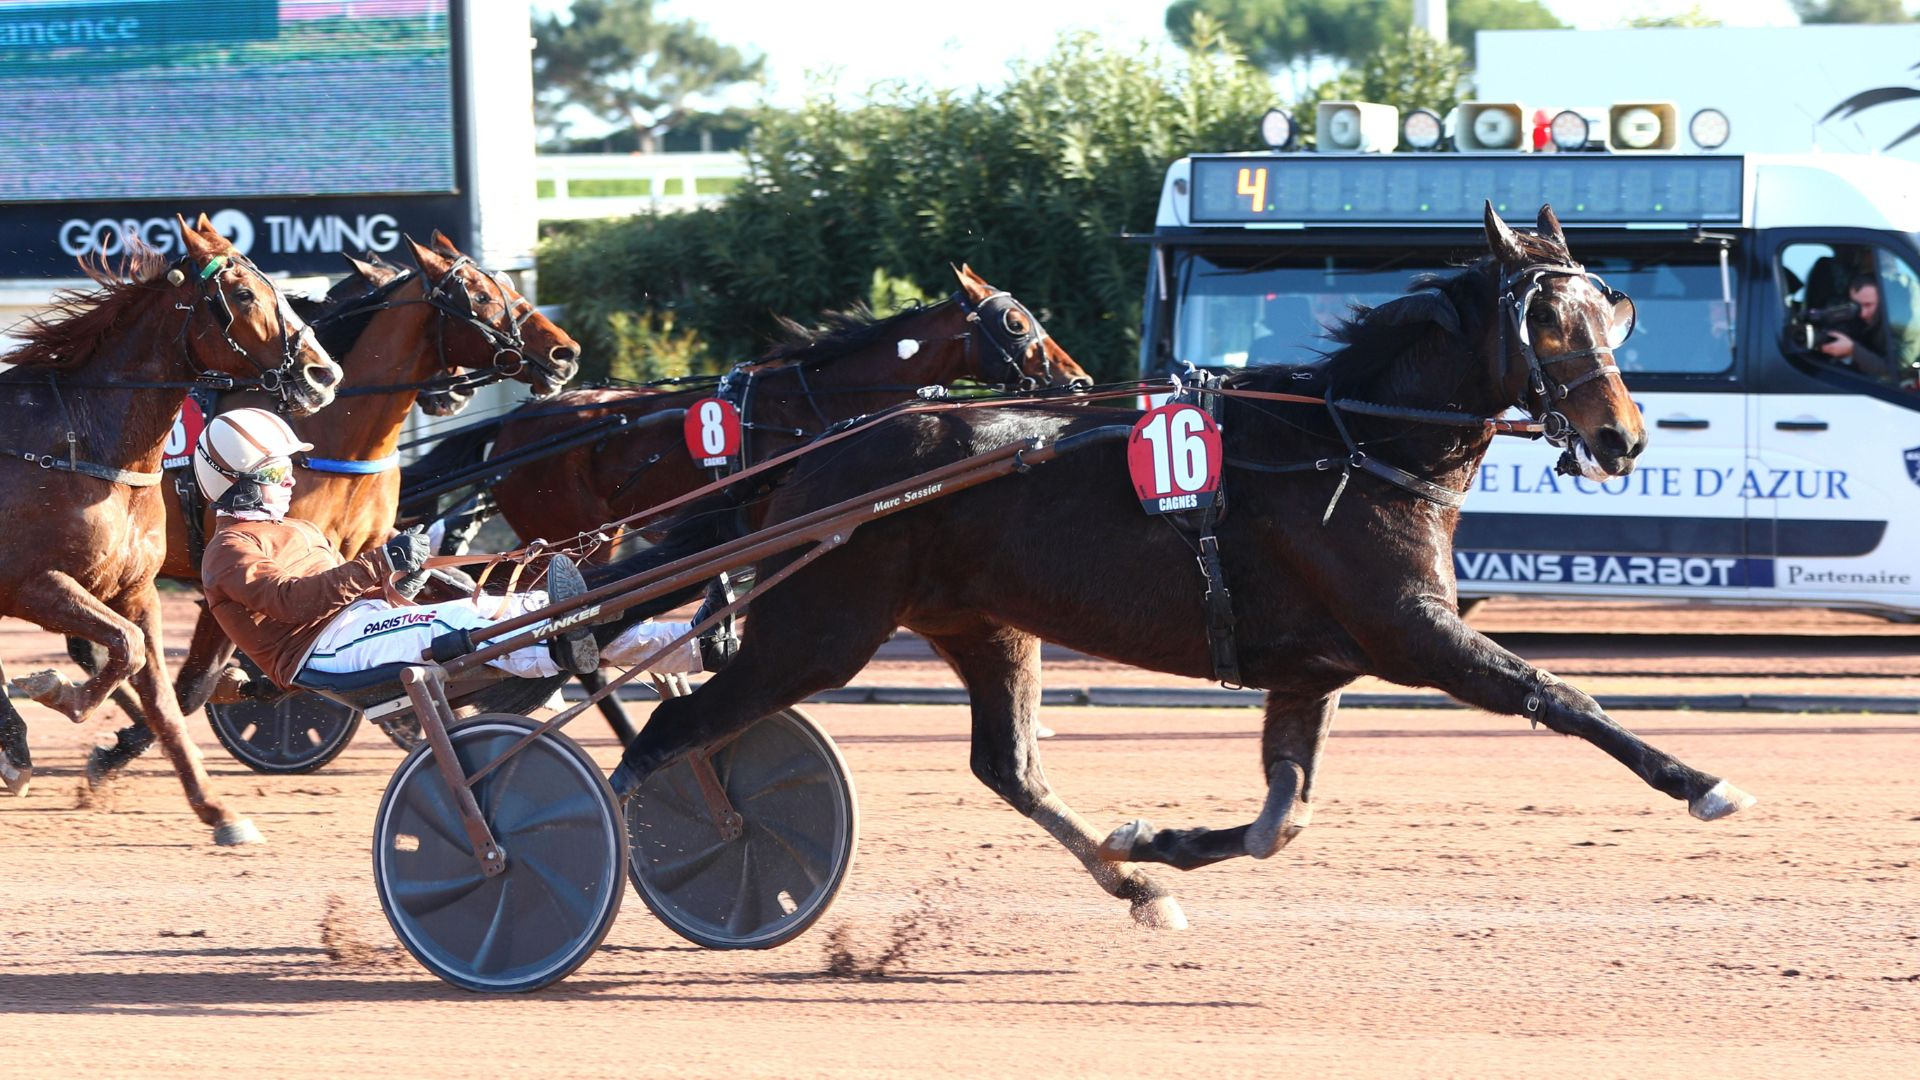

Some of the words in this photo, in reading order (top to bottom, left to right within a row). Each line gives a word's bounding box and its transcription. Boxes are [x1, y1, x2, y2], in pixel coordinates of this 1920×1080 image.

[1237, 168, 1268, 212] 4
[264, 214, 399, 254] TIMING
[700, 401, 725, 455] 8
[163, 456, 191, 469] CAGNES
[1142, 408, 1208, 495] 16
[1511, 465, 1562, 494] LA
[873, 496, 901, 514] Marc
[904, 482, 943, 503] Sassier
[1158, 494, 1198, 511] CAGNES
[1456, 552, 1563, 582] VANS
[1571, 556, 1737, 587] BARBOT
[1788, 565, 1912, 585] Partenaire
[532, 604, 602, 638] YANKEE
